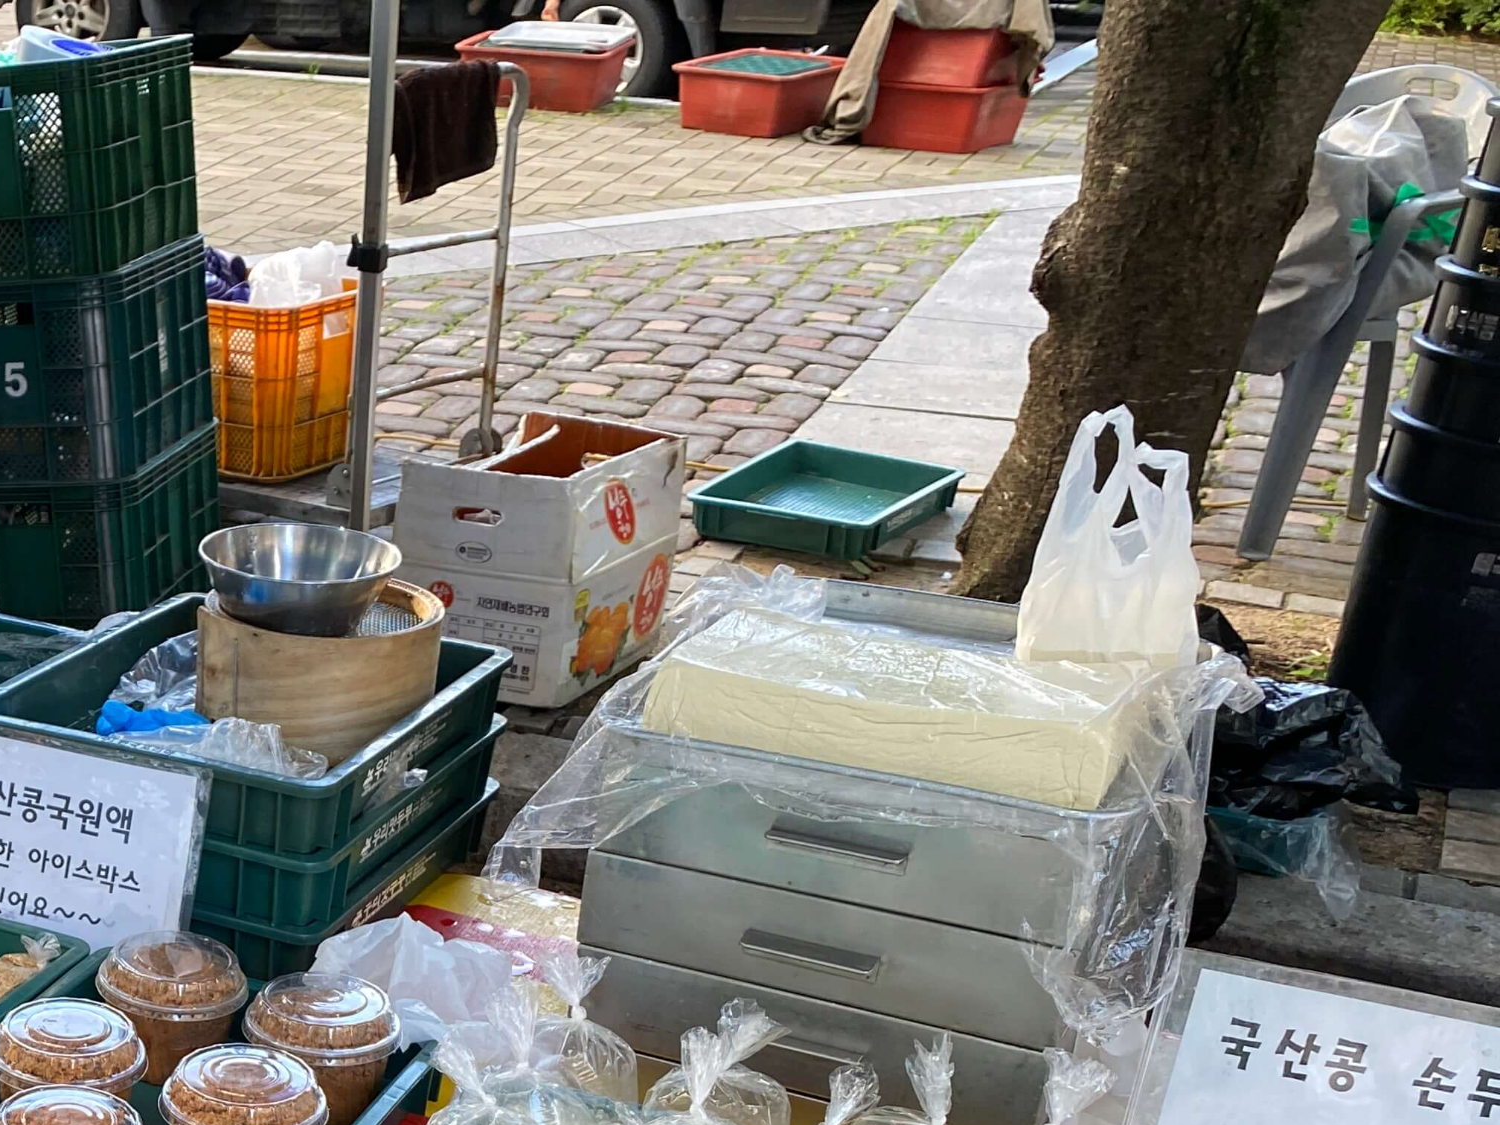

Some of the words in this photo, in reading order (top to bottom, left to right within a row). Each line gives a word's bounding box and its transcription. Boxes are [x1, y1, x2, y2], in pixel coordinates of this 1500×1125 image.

[4, 361, 28, 397] 5
[28, 848, 141, 894] 아이스박스
[1220, 1017, 1368, 1092] 국산콩
